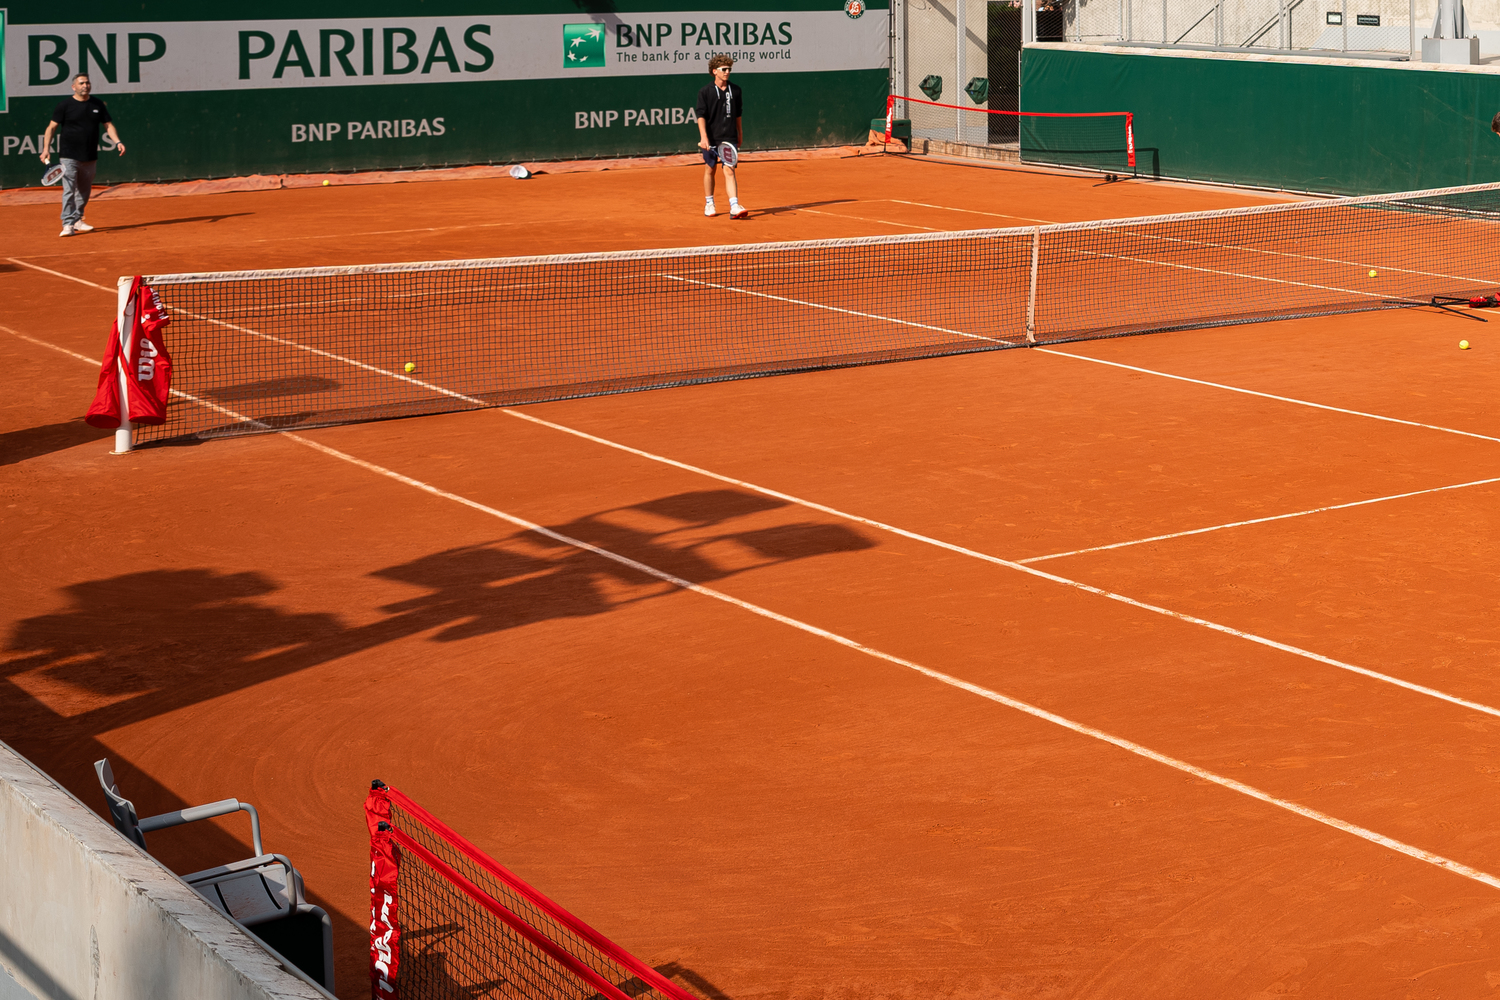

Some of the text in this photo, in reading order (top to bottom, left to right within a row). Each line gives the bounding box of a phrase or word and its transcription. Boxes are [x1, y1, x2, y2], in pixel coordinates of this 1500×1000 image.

[616, 21, 793, 48] BNP PARIBAS
[27, 23, 495, 87] BNP PARIBAS
[617, 52, 638, 62] The
[642, 51, 670, 62] bank
[673, 50, 690, 63] for
[694, 52, 701, 60] a
[759, 49, 791, 60] world
[291, 117, 446, 143] BNP PARIBAS
[574, 106, 699, 129] BNP PARIBA
